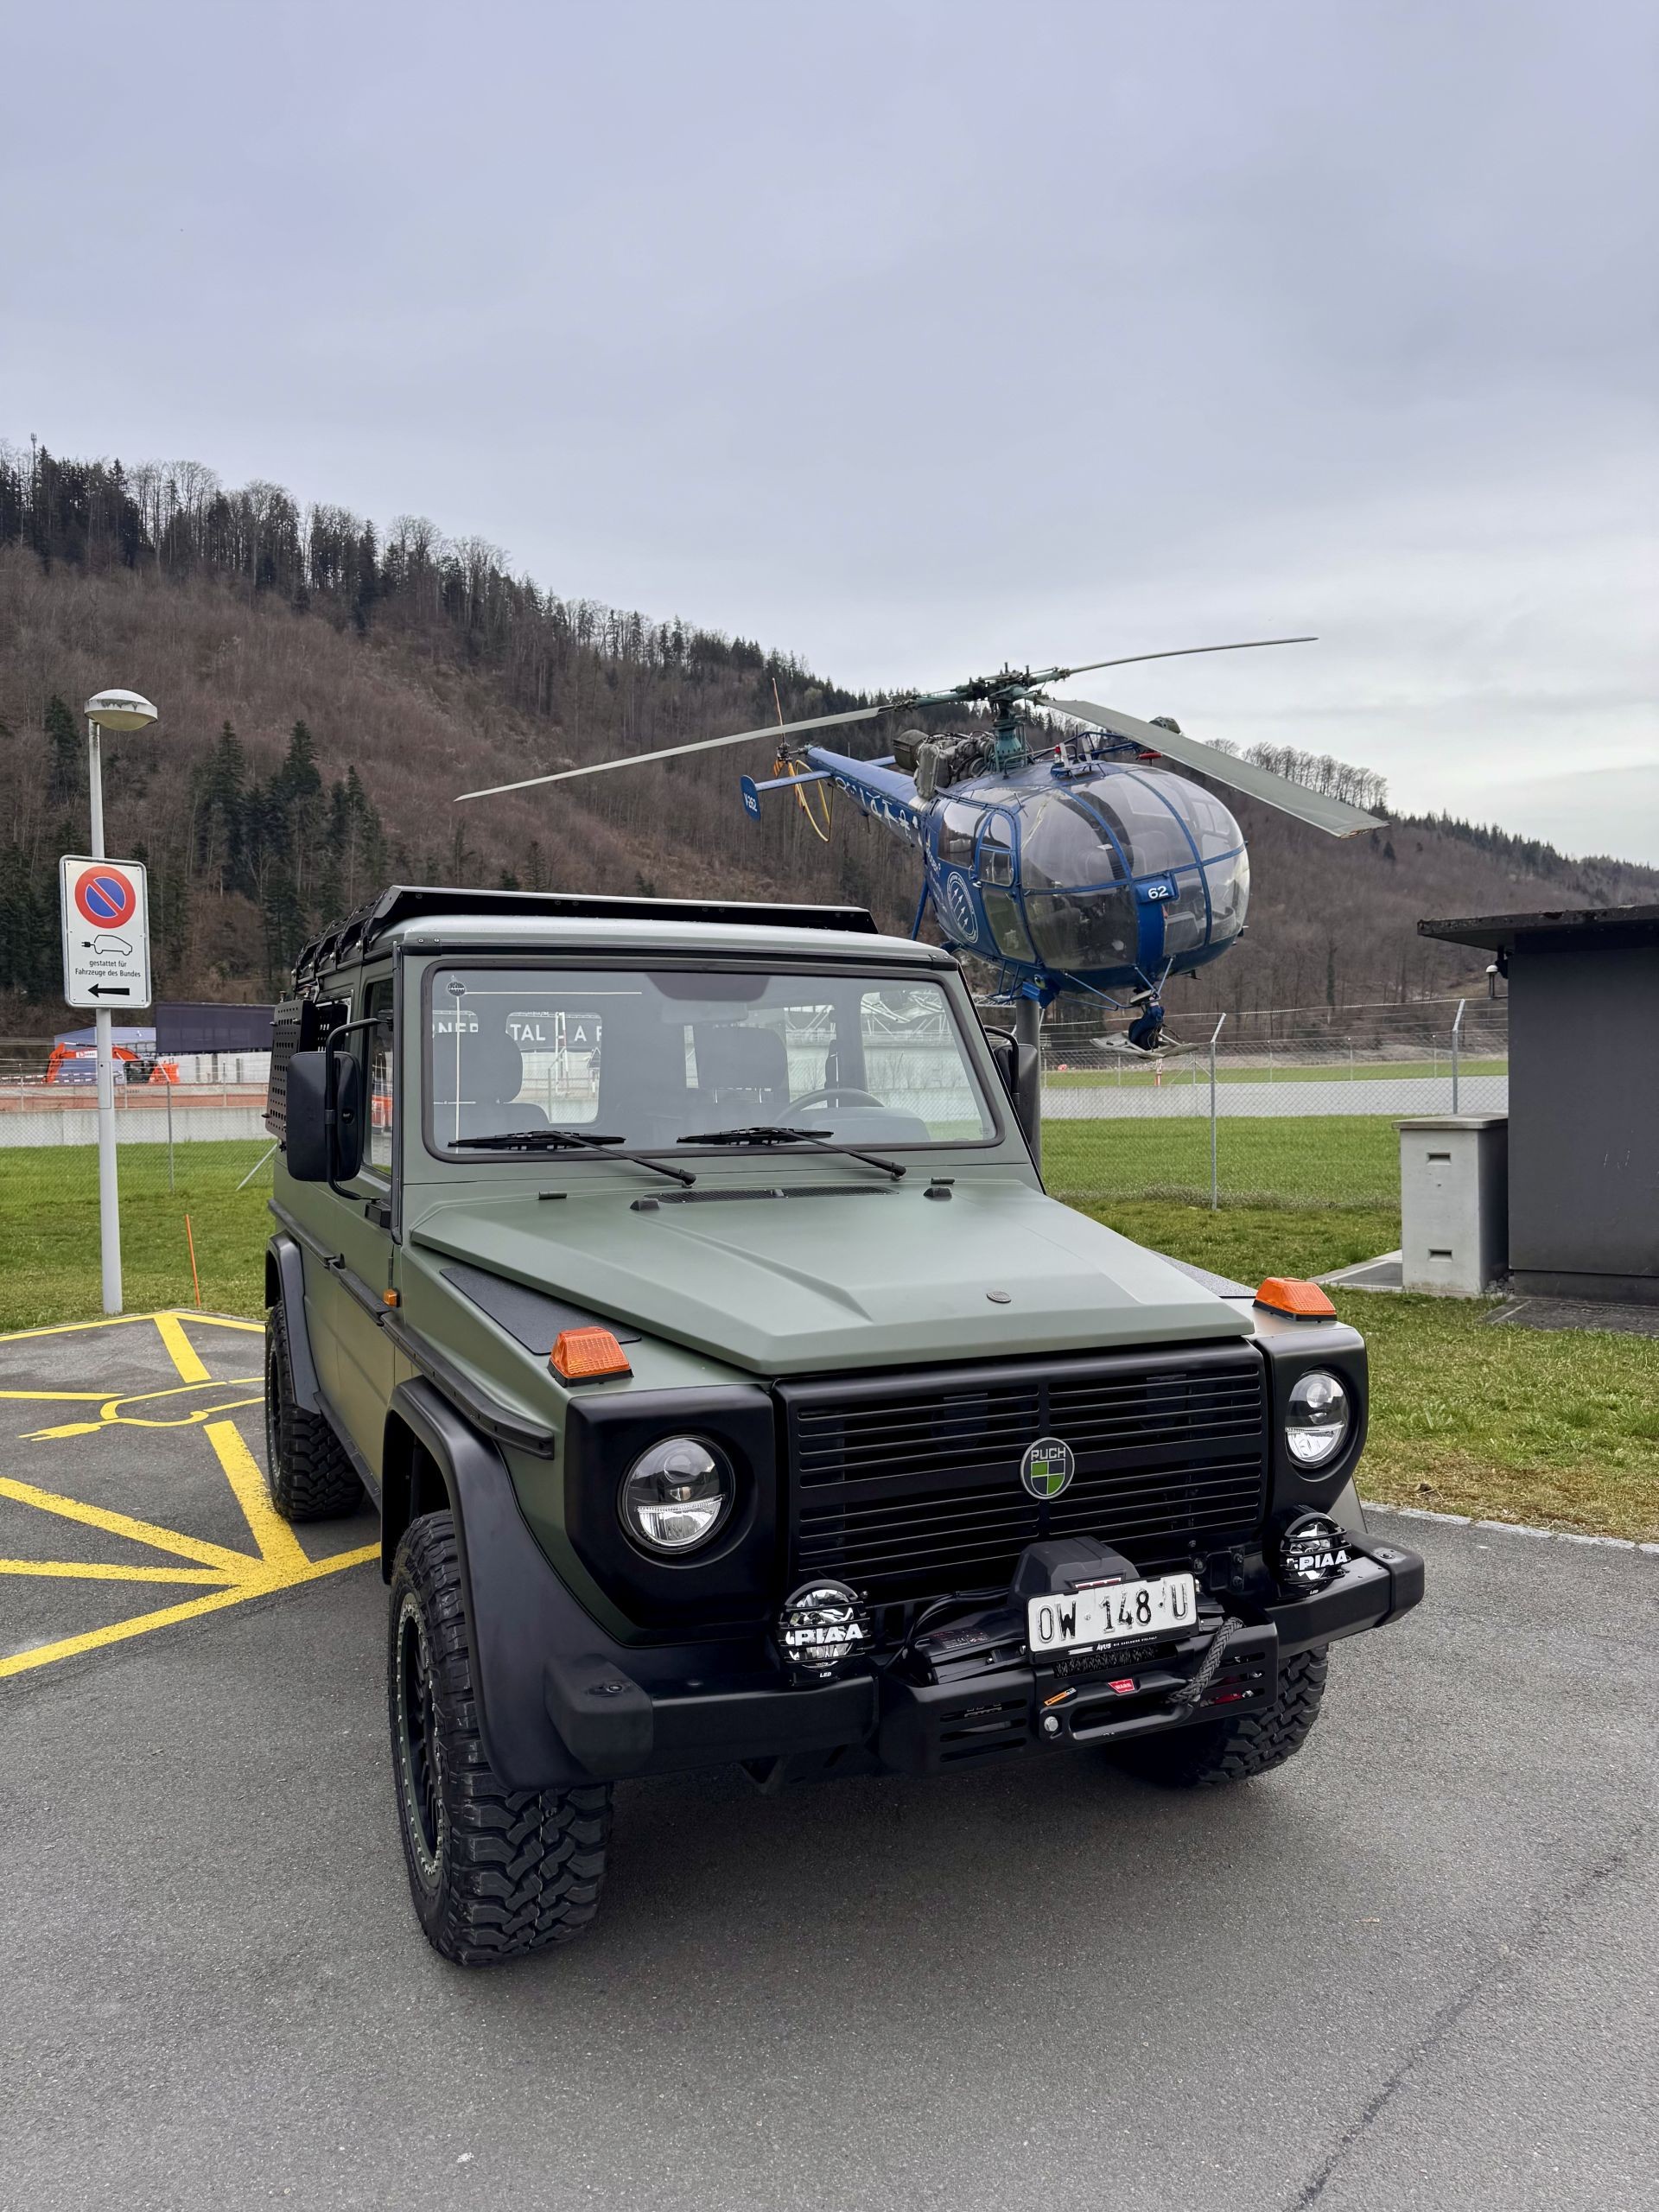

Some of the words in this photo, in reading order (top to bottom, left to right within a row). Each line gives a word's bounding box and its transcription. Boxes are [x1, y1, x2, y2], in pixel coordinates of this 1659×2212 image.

[1147, 886, 1169, 899] 62
[75, 968, 106, 977] Fahrzeuge
[1031, 1446, 1066, 1460] PUCH
[1299, 1550, 1348, 1570] PIAA
[1037, 1599, 1077, 1643] OW
[1099, 1588, 1152, 1634] 148
[1171, 1582, 1188, 1620] U
[795, 1624, 863, 1646] PIAA
